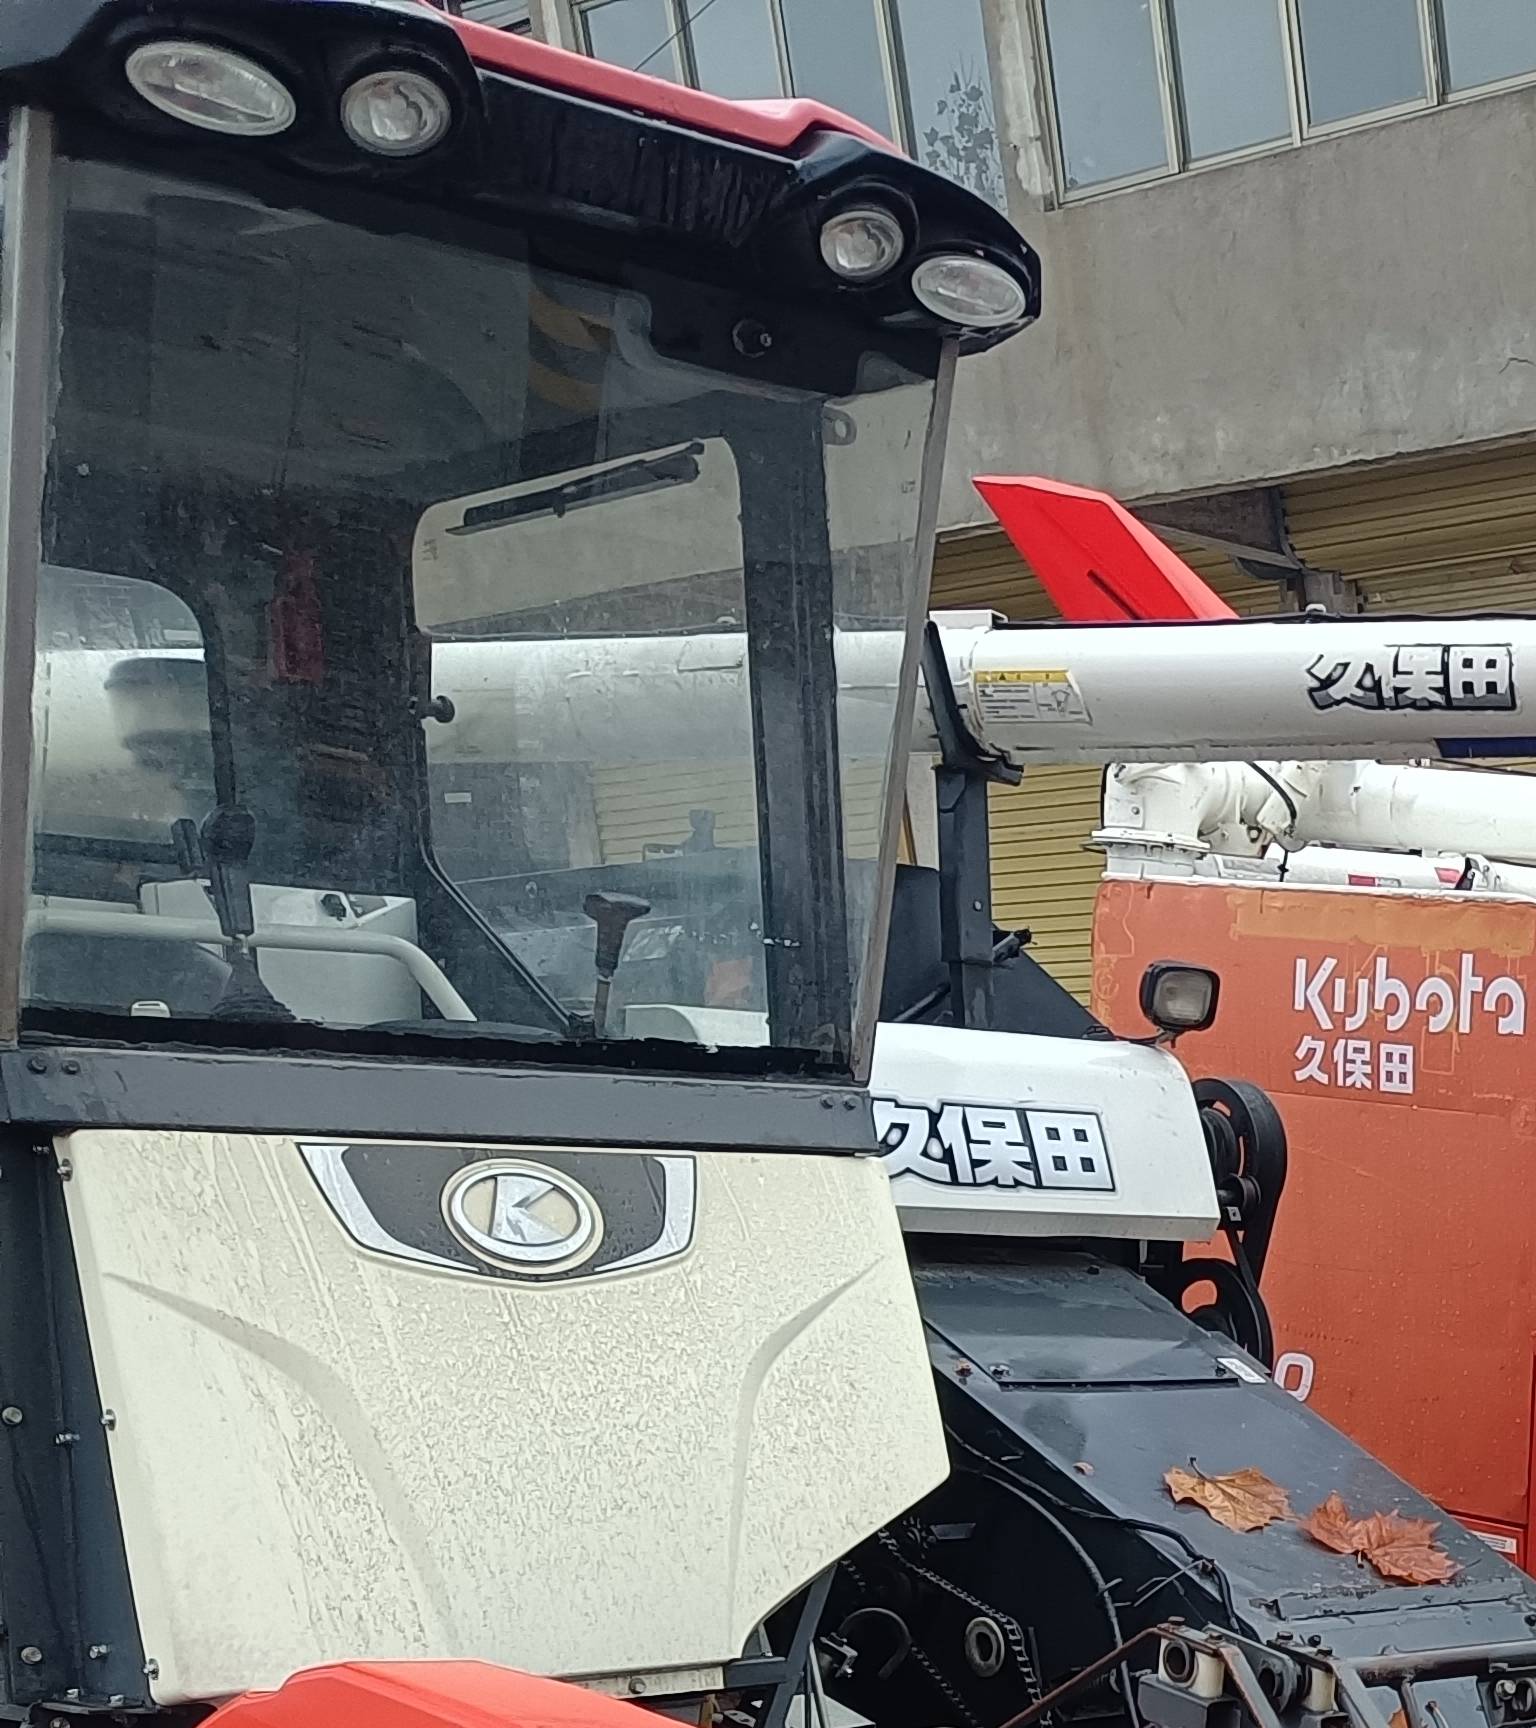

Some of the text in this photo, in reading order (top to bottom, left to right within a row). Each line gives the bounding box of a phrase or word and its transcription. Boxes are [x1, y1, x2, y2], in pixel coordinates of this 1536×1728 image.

[1306, 645, 1518, 710] 久保田
[1293, 952, 1527, 1036] Kubota
[1293, 1035, 1415, 1095] 久保田
[873, 1097, 1116, 1191] 久保田
